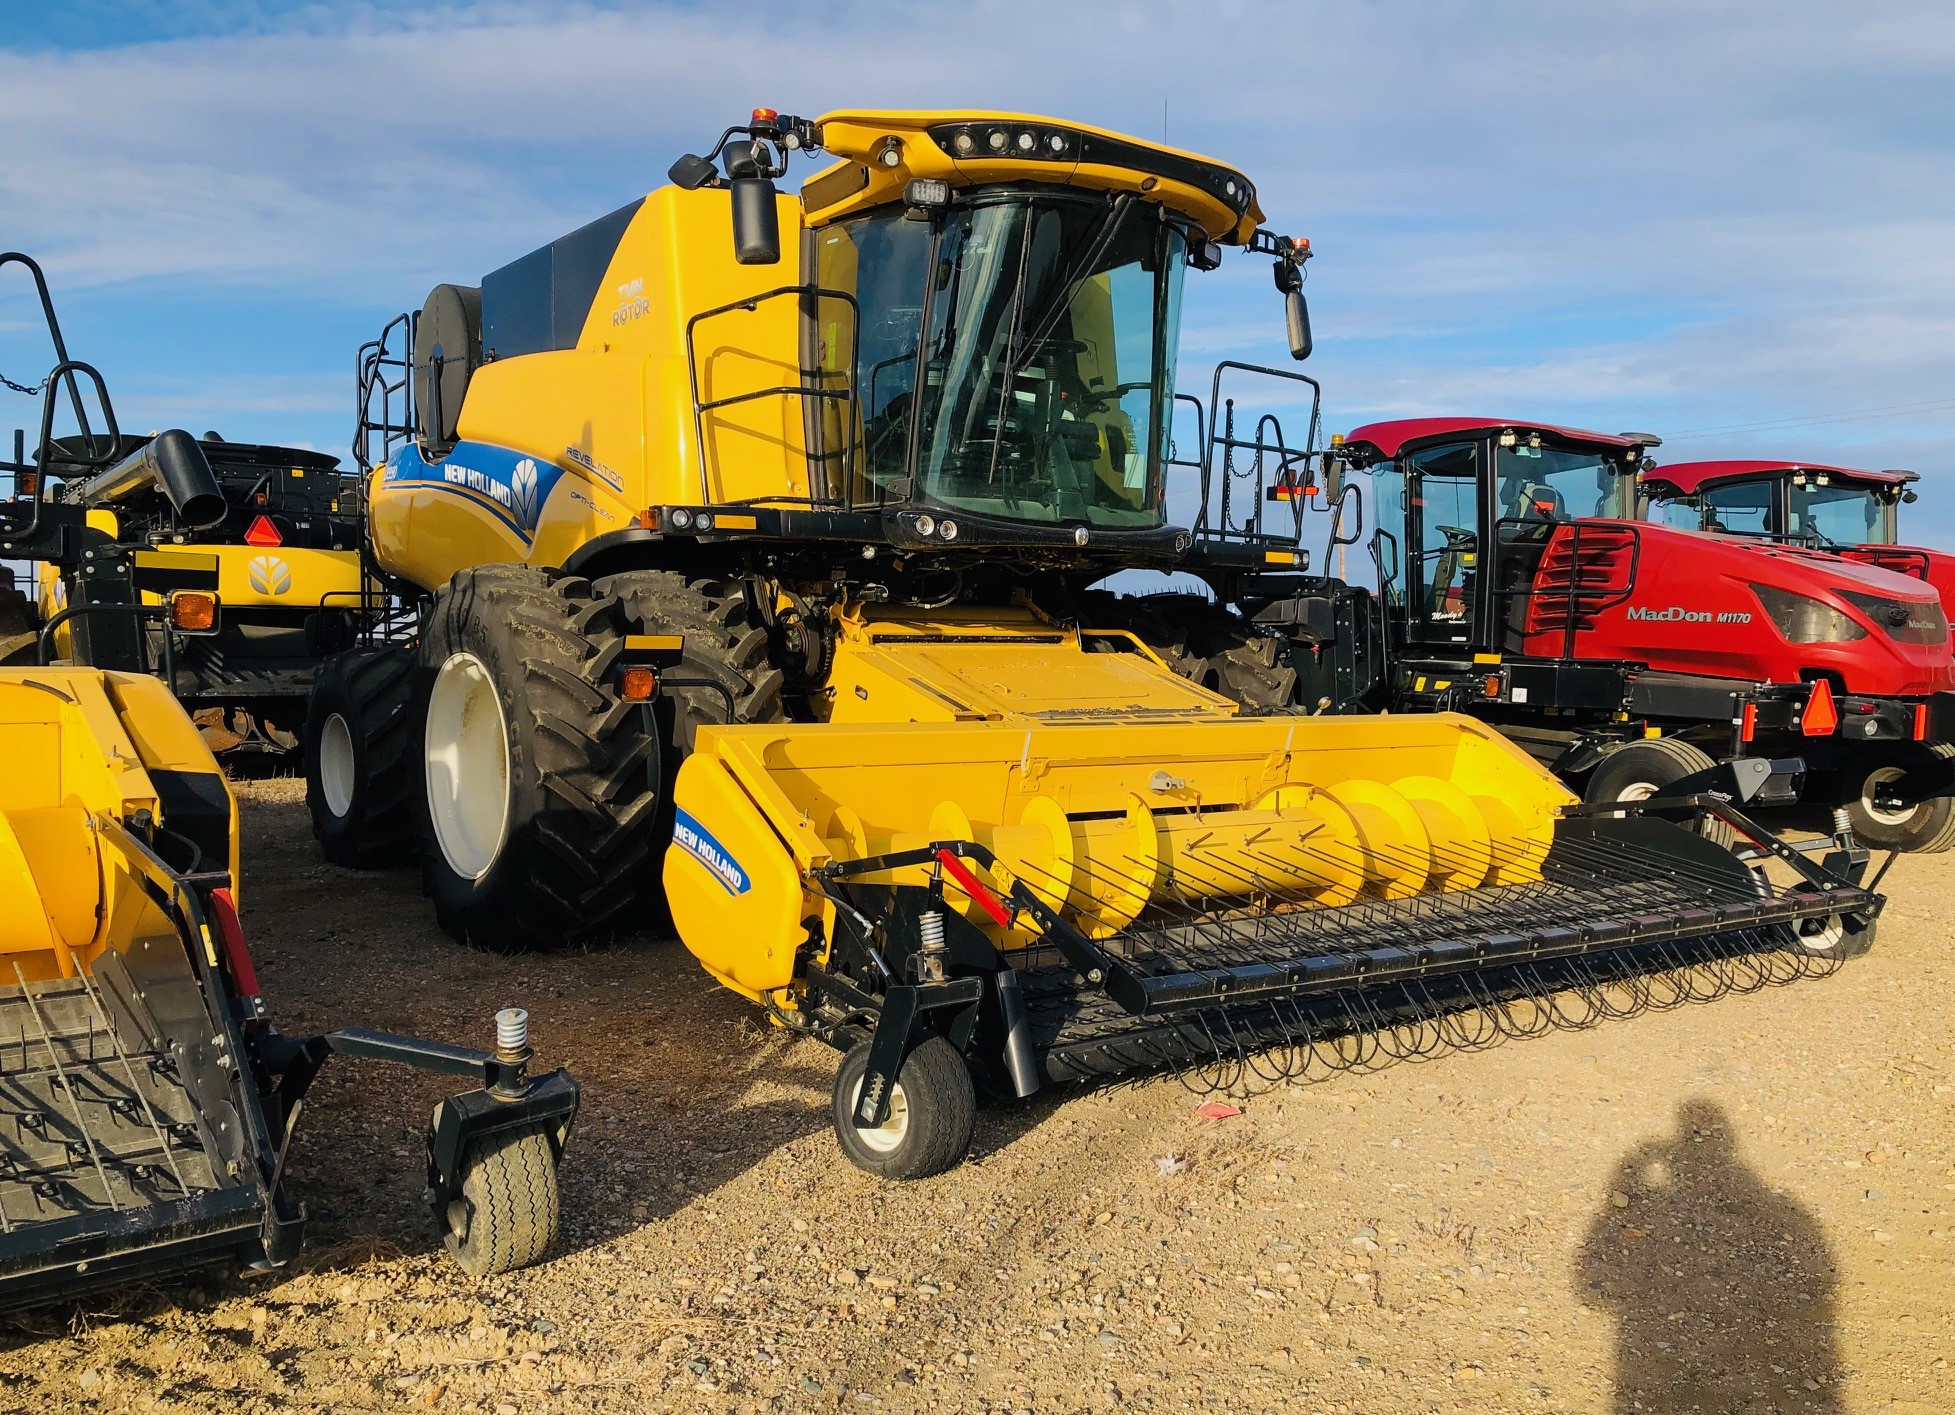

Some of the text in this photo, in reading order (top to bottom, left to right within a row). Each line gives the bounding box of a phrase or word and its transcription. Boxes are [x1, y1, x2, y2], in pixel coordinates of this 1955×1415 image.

[618, 276, 643, 302] TWIN
[612, 296, 650, 327] ROTOR
[566, 446, 625, 488] REVELATION
[444, 463, 512, 508] NEW HOLLAND
[1627, 606, 1752, 624] MacDon M1170
[674, 821, 742, 888] NEW HOLLAND
